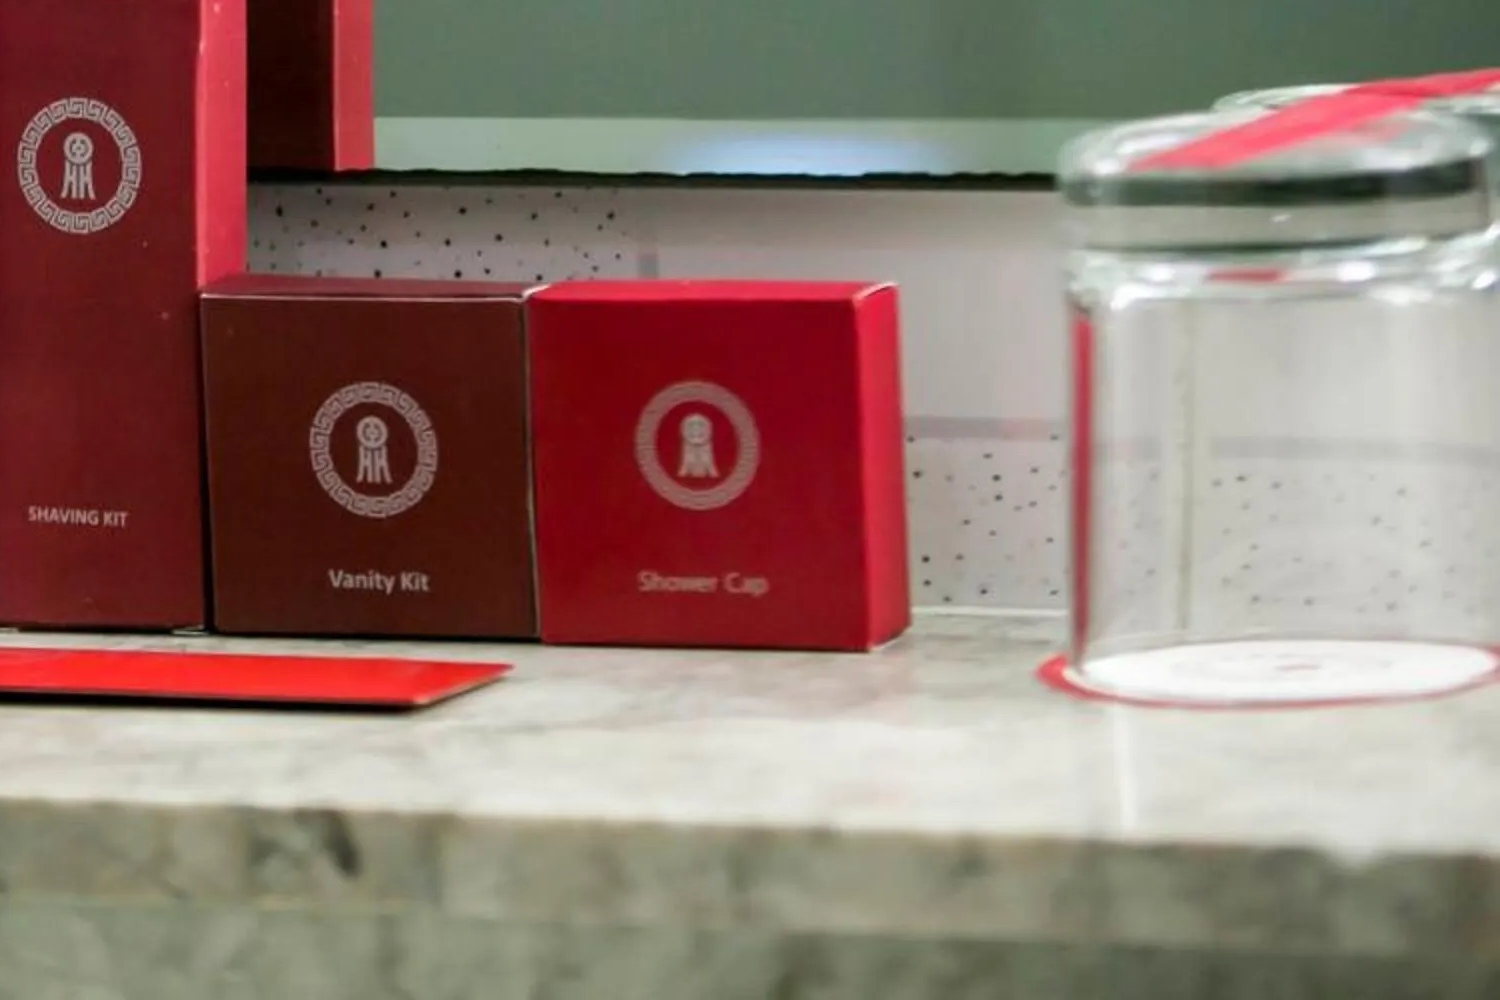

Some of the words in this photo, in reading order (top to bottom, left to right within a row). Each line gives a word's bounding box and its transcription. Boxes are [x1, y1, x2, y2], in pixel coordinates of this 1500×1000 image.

[27, 504, 100, 527] SHAVING
[102, 510, 128, 529] KIT
[327, 568, 396, 596] Vanity
[400, 570, 431, 593] Kit
[636, 570, 719, 594] Shower
[722, 571, 770, 599] Cap
